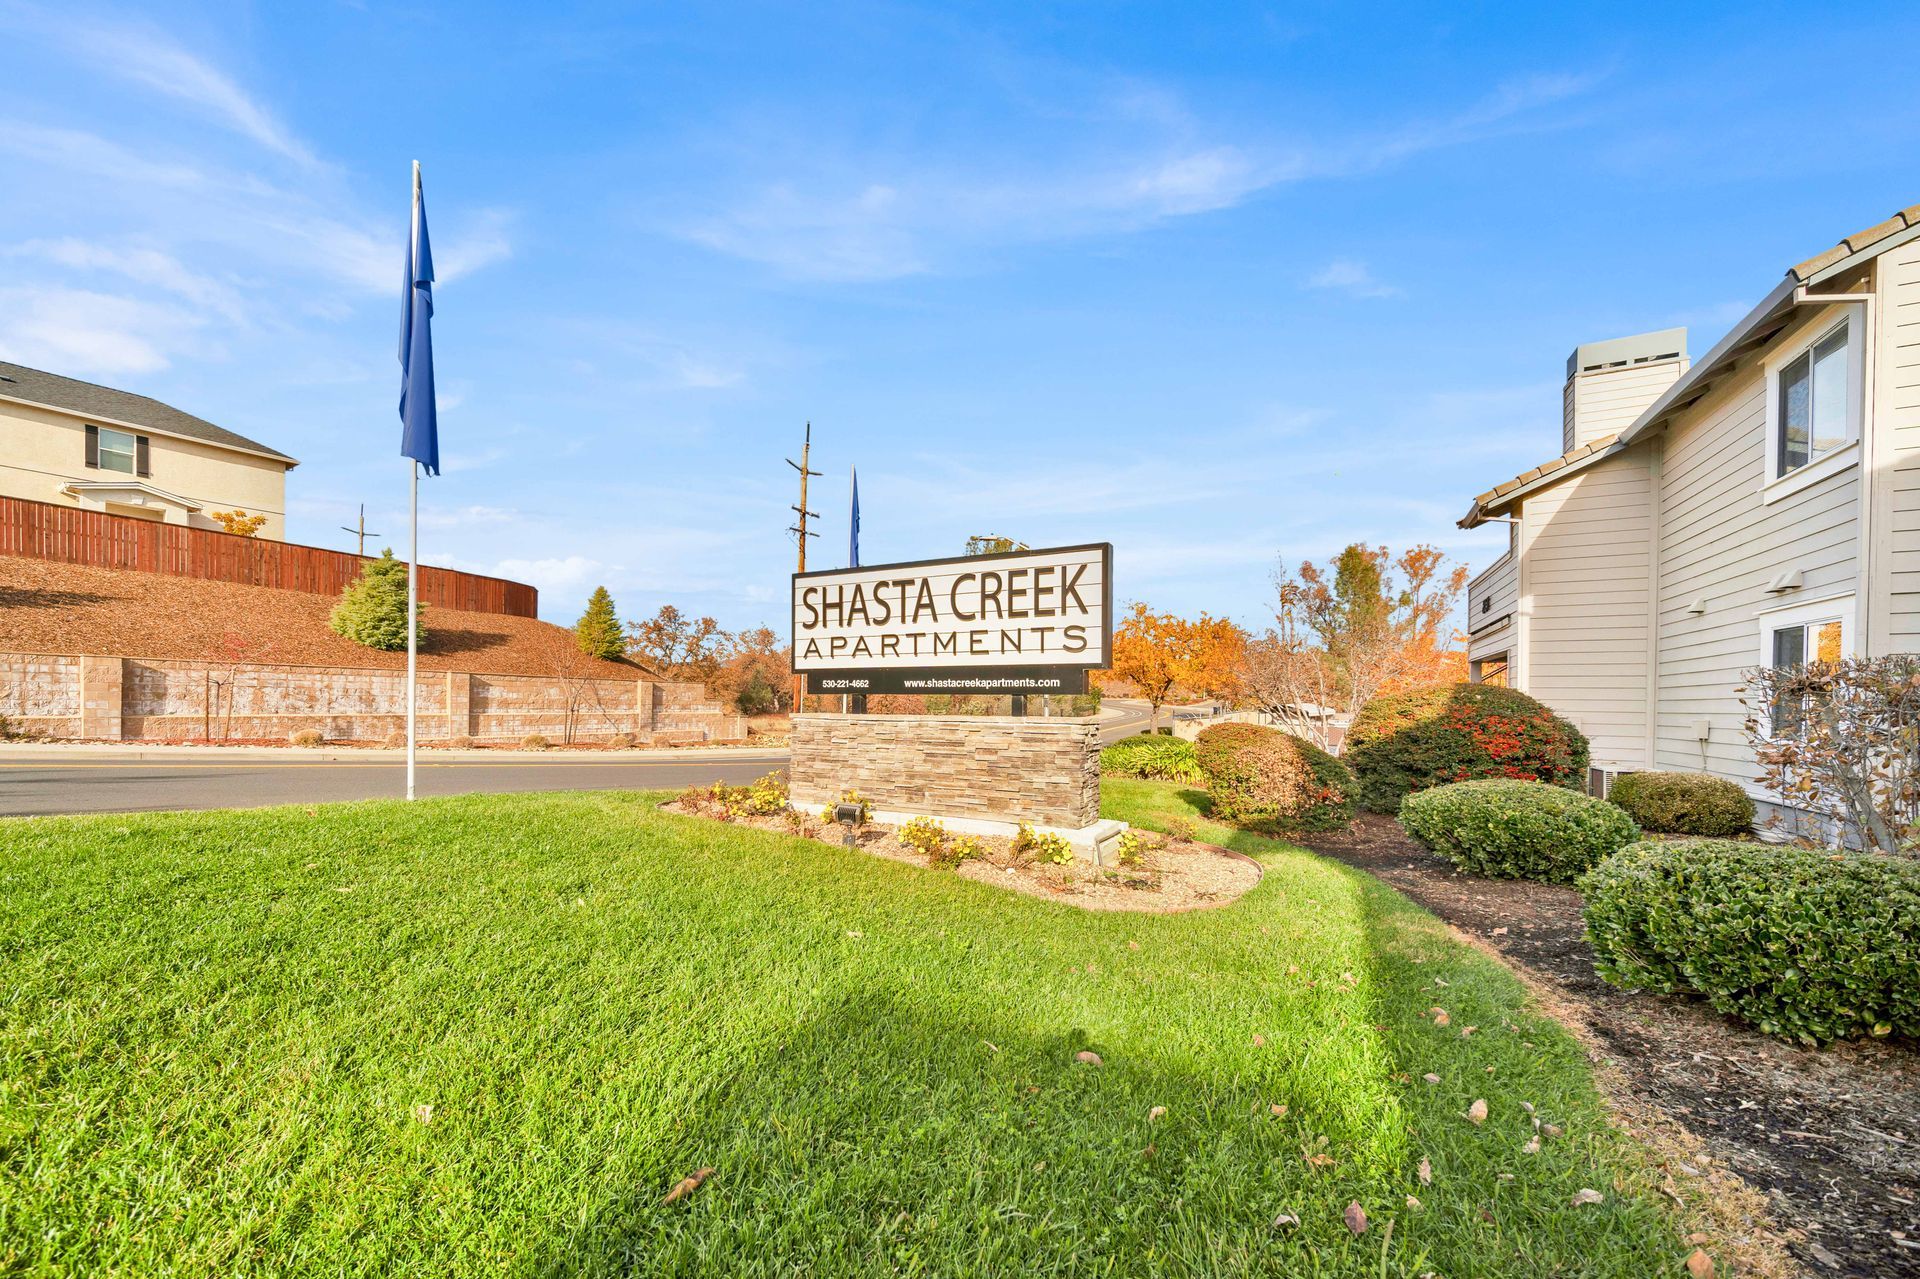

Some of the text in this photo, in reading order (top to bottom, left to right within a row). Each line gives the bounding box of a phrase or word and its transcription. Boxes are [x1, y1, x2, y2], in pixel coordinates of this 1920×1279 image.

[802, 564, 1089, 630] SHASTA CREEK
[803, 625, 1088, 659] APARTMENTS
[822, 679, 869, 688] 530-221-4662
[904, 677, 1060, 689] www.shastacreekapartments.com
